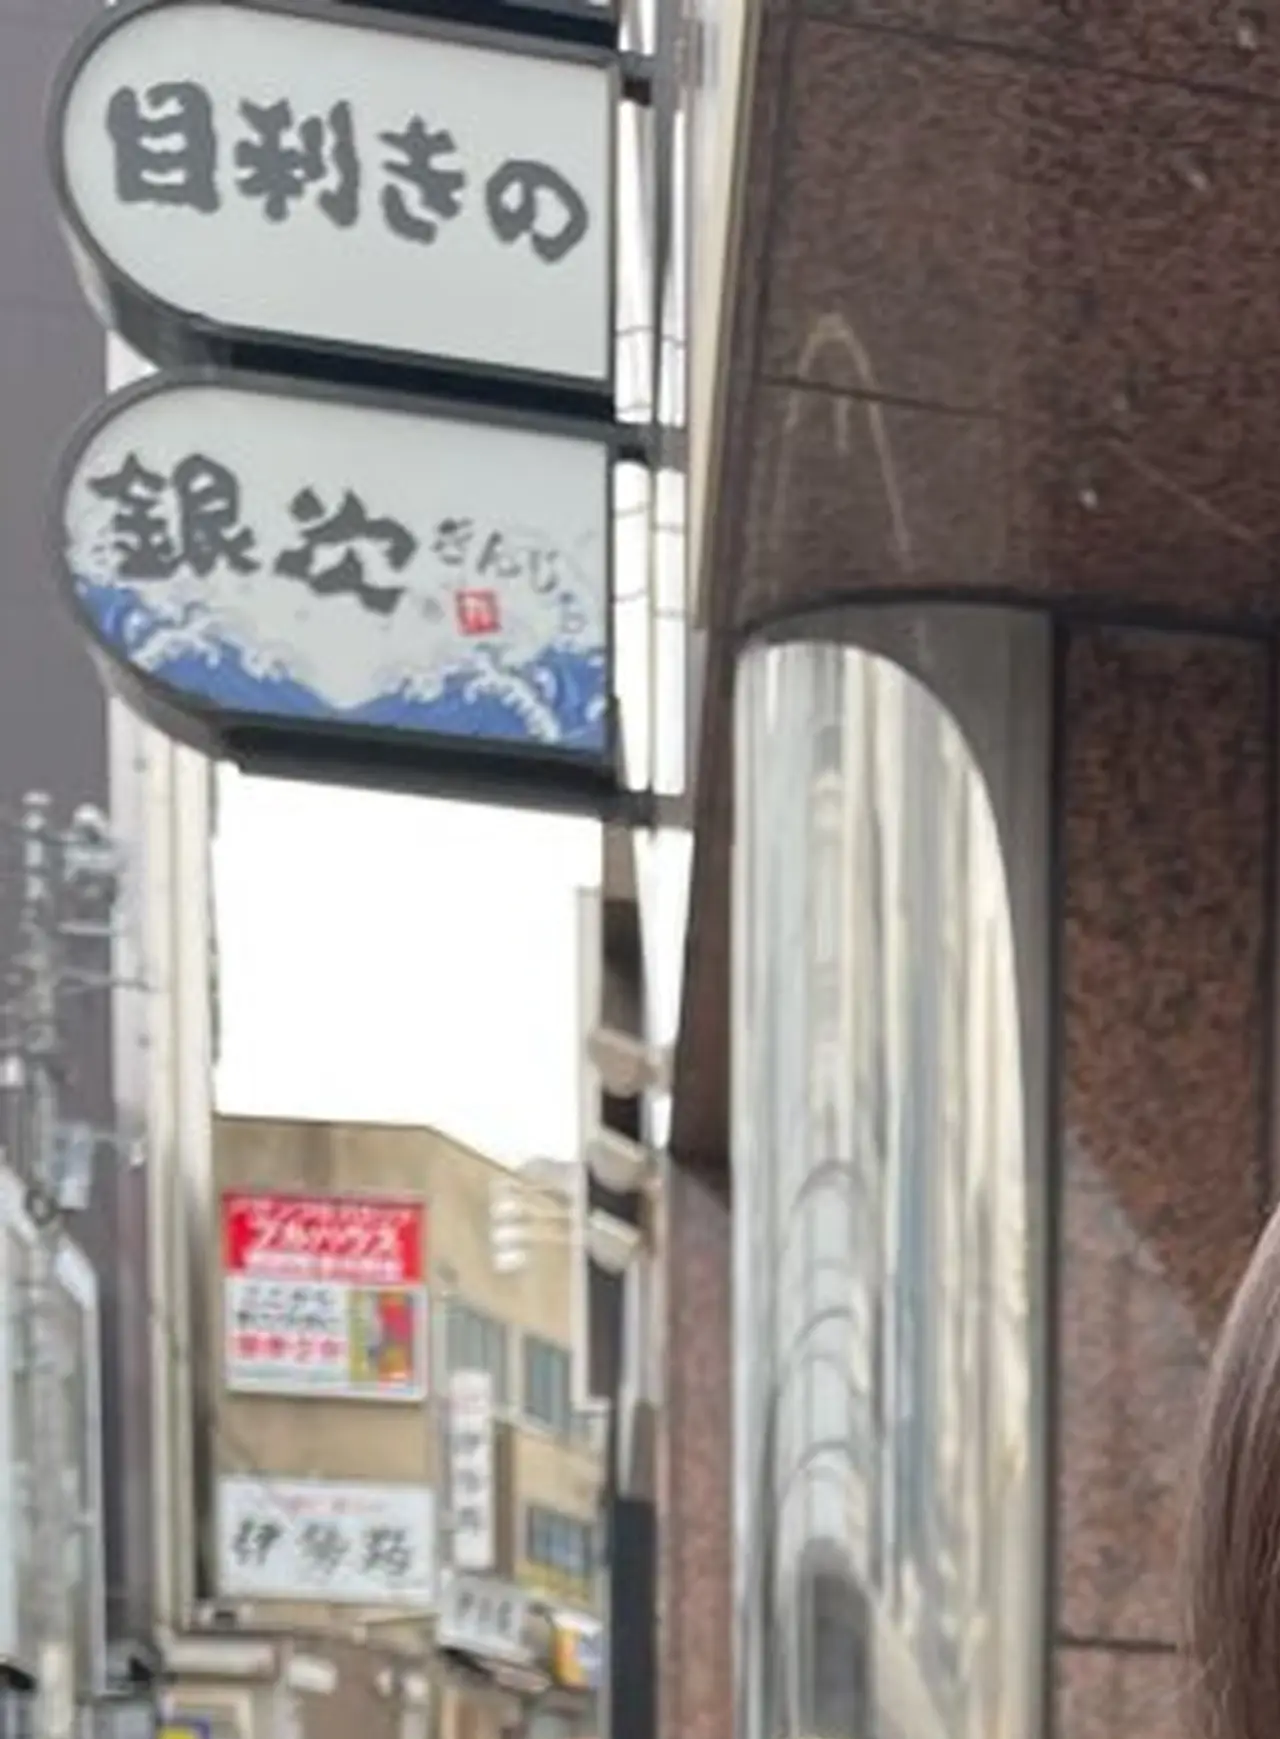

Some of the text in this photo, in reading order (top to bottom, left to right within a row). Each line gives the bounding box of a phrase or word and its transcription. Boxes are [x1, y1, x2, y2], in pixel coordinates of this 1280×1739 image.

[105, 80, 589, 264] 目利きの
[87, 452, 417, 614] 銀次
